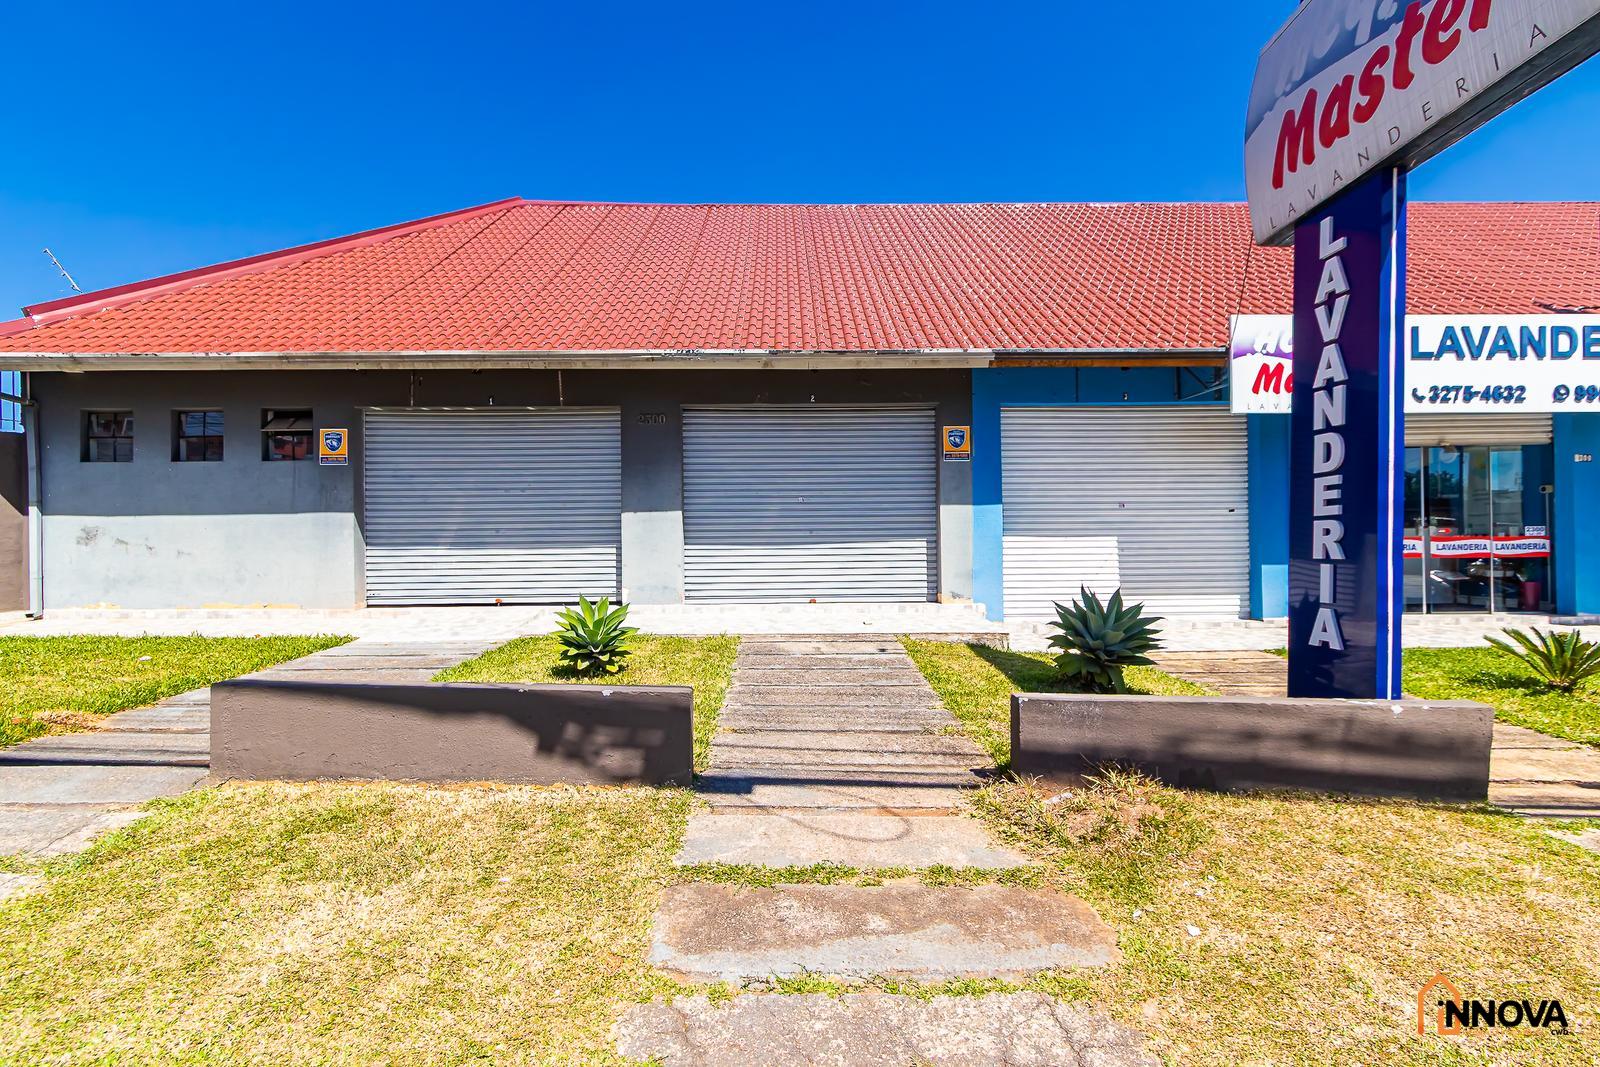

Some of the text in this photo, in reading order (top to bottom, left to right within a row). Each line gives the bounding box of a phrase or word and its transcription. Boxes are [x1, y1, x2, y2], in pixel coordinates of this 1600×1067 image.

[1269, 23, 1547, 230] LAVANDERIA
[1411, 326, 1600, 360] LAVANDE
[1574, 385, 1600, 404] 99
[1308, 216, 1350, 651] LAVANDERIA
[1436, 543, 1488, 551] LAVANDERIA
[1495, 542, 1547, 551] LAVANDERIA
